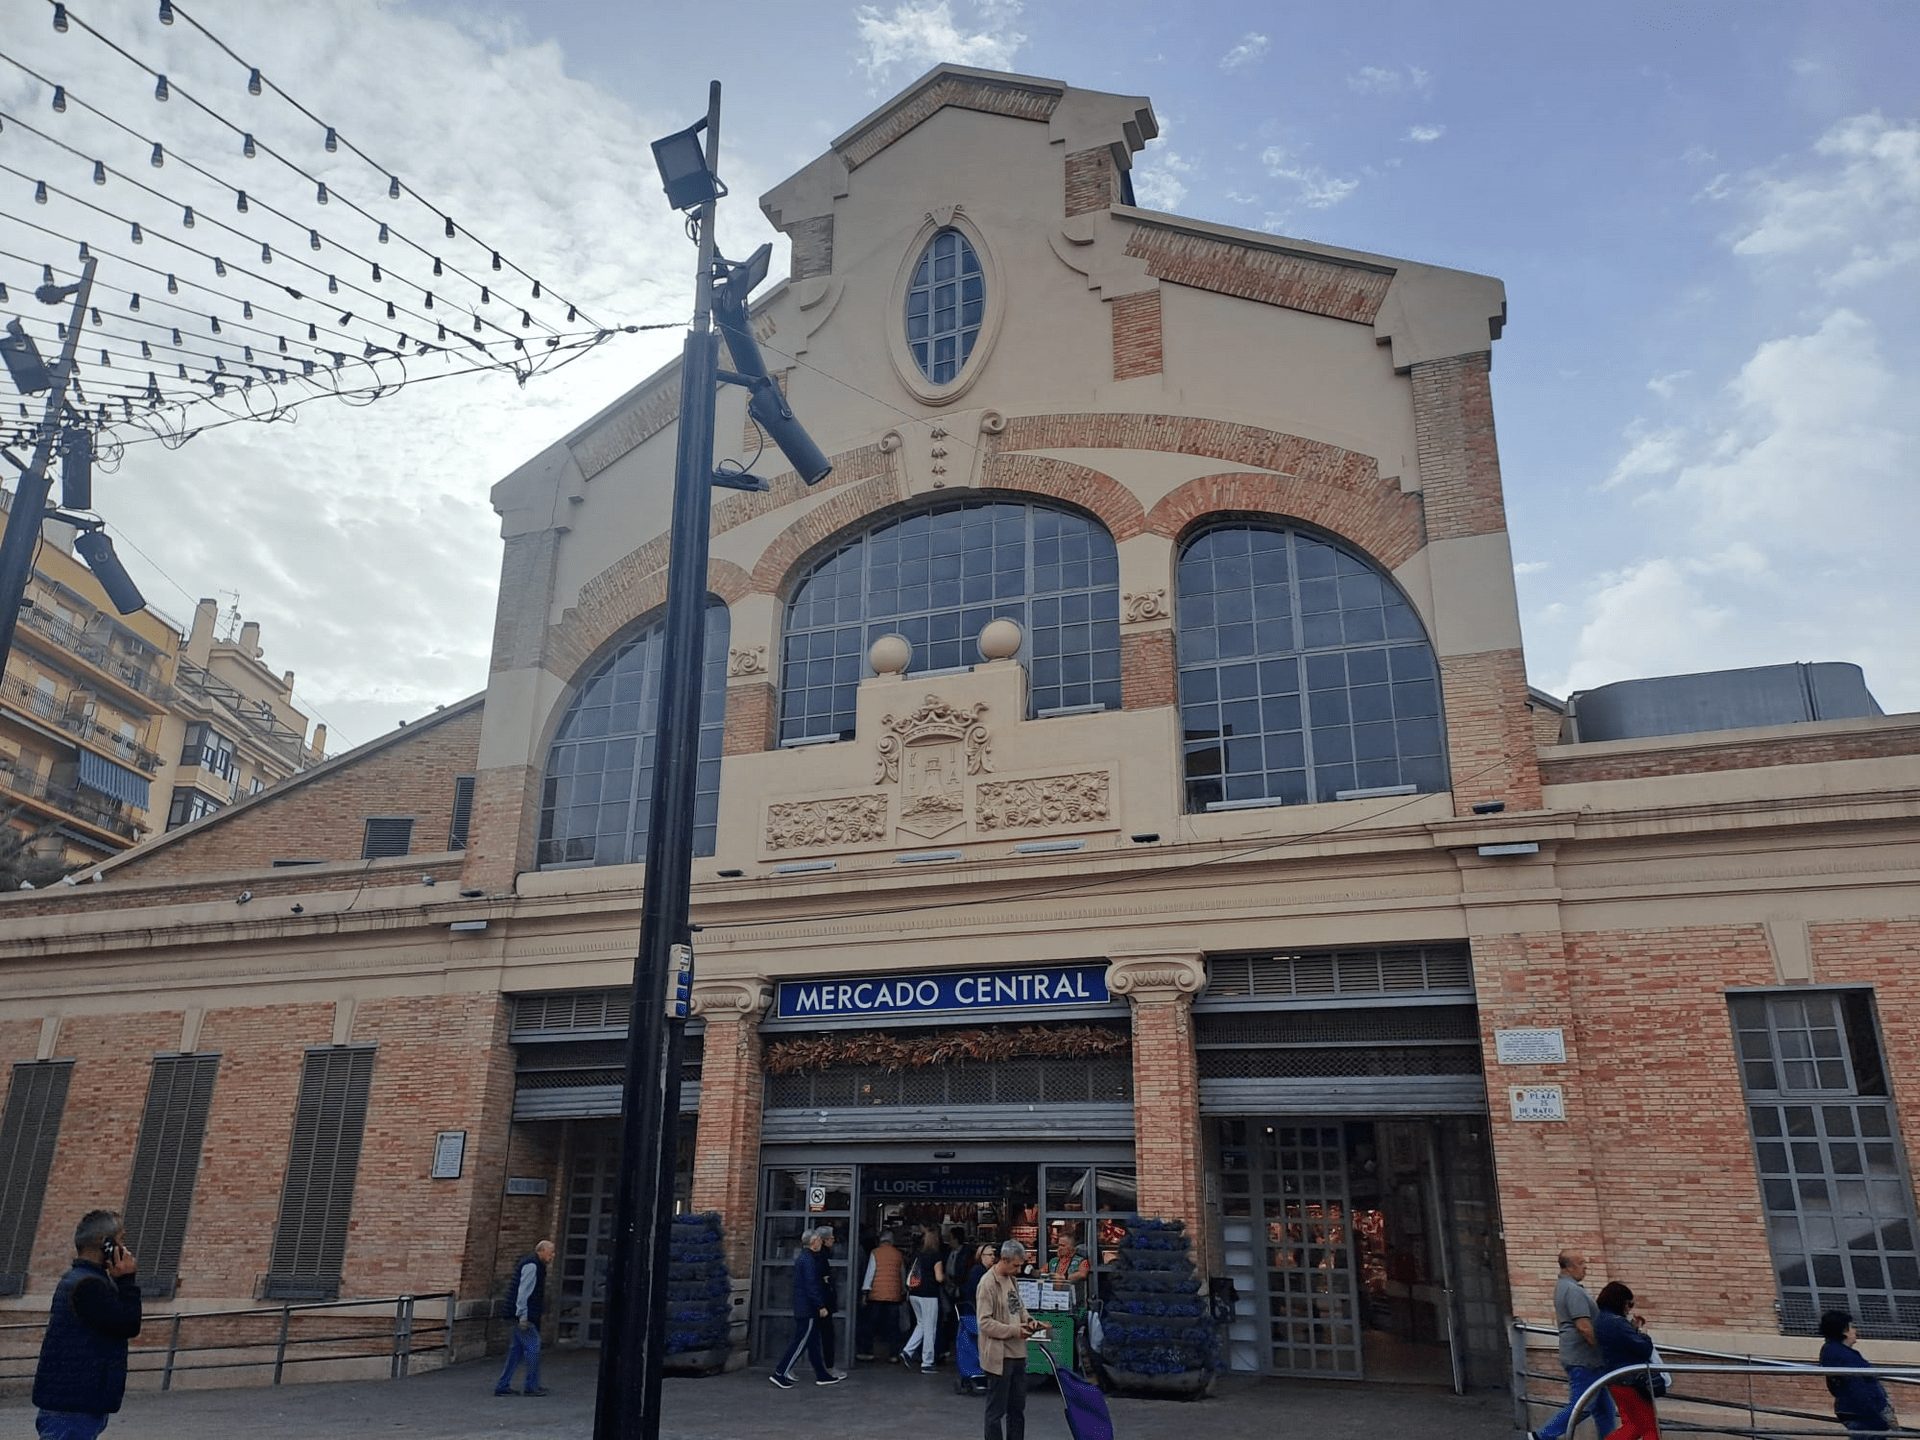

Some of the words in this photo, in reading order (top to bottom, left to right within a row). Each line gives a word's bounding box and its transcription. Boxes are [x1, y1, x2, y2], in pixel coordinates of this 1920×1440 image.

[796, 980, 939, 1011] MERCADO
[955, 972, 1090, 1004] CENTRAL
[873, 1179, 937, 1193] LLORET
